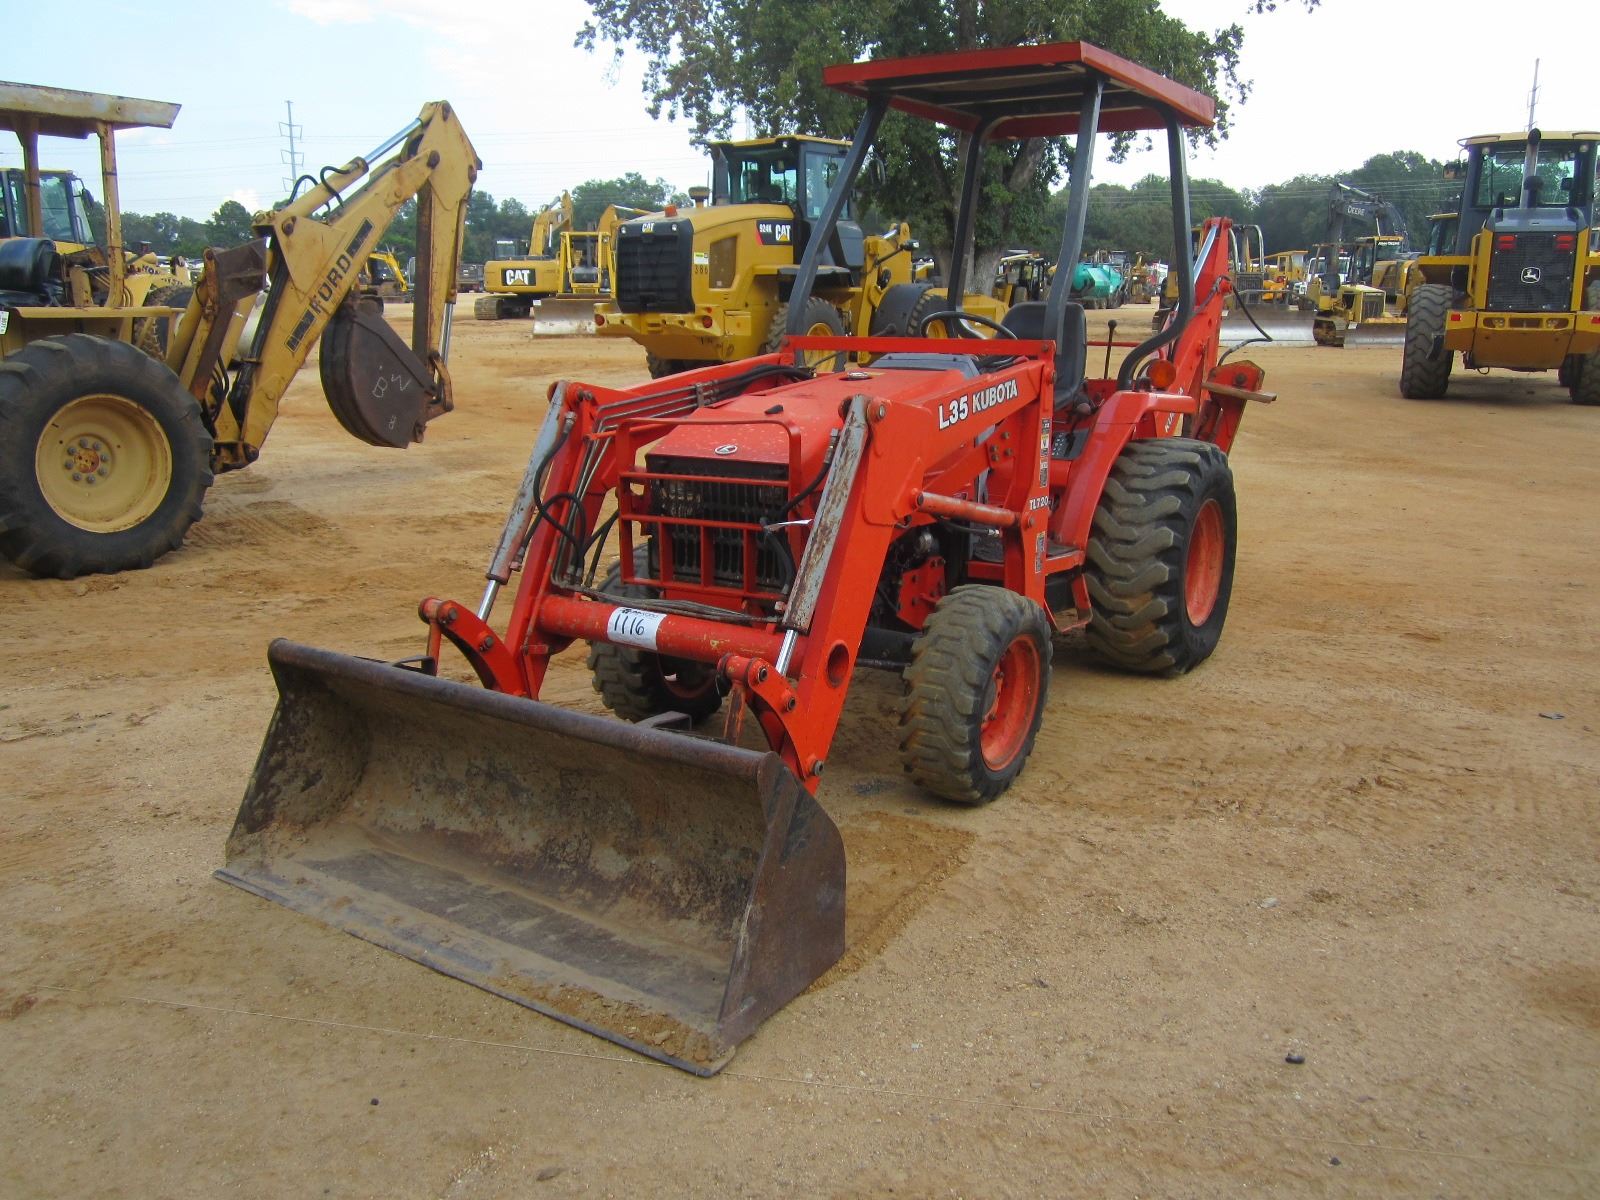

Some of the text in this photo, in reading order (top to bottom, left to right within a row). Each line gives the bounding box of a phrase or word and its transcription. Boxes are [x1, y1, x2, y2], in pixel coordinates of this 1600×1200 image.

[1347, 205, 1366, 216] DEERE
[641, 222, 655, 233] CAT
[775, 224, 791, 241] CAT
[505, 269, 530, 286] CAT
[938, 379, 1018, 430] L35 KUBOTA
[613, 613, 645, 636] 1116
